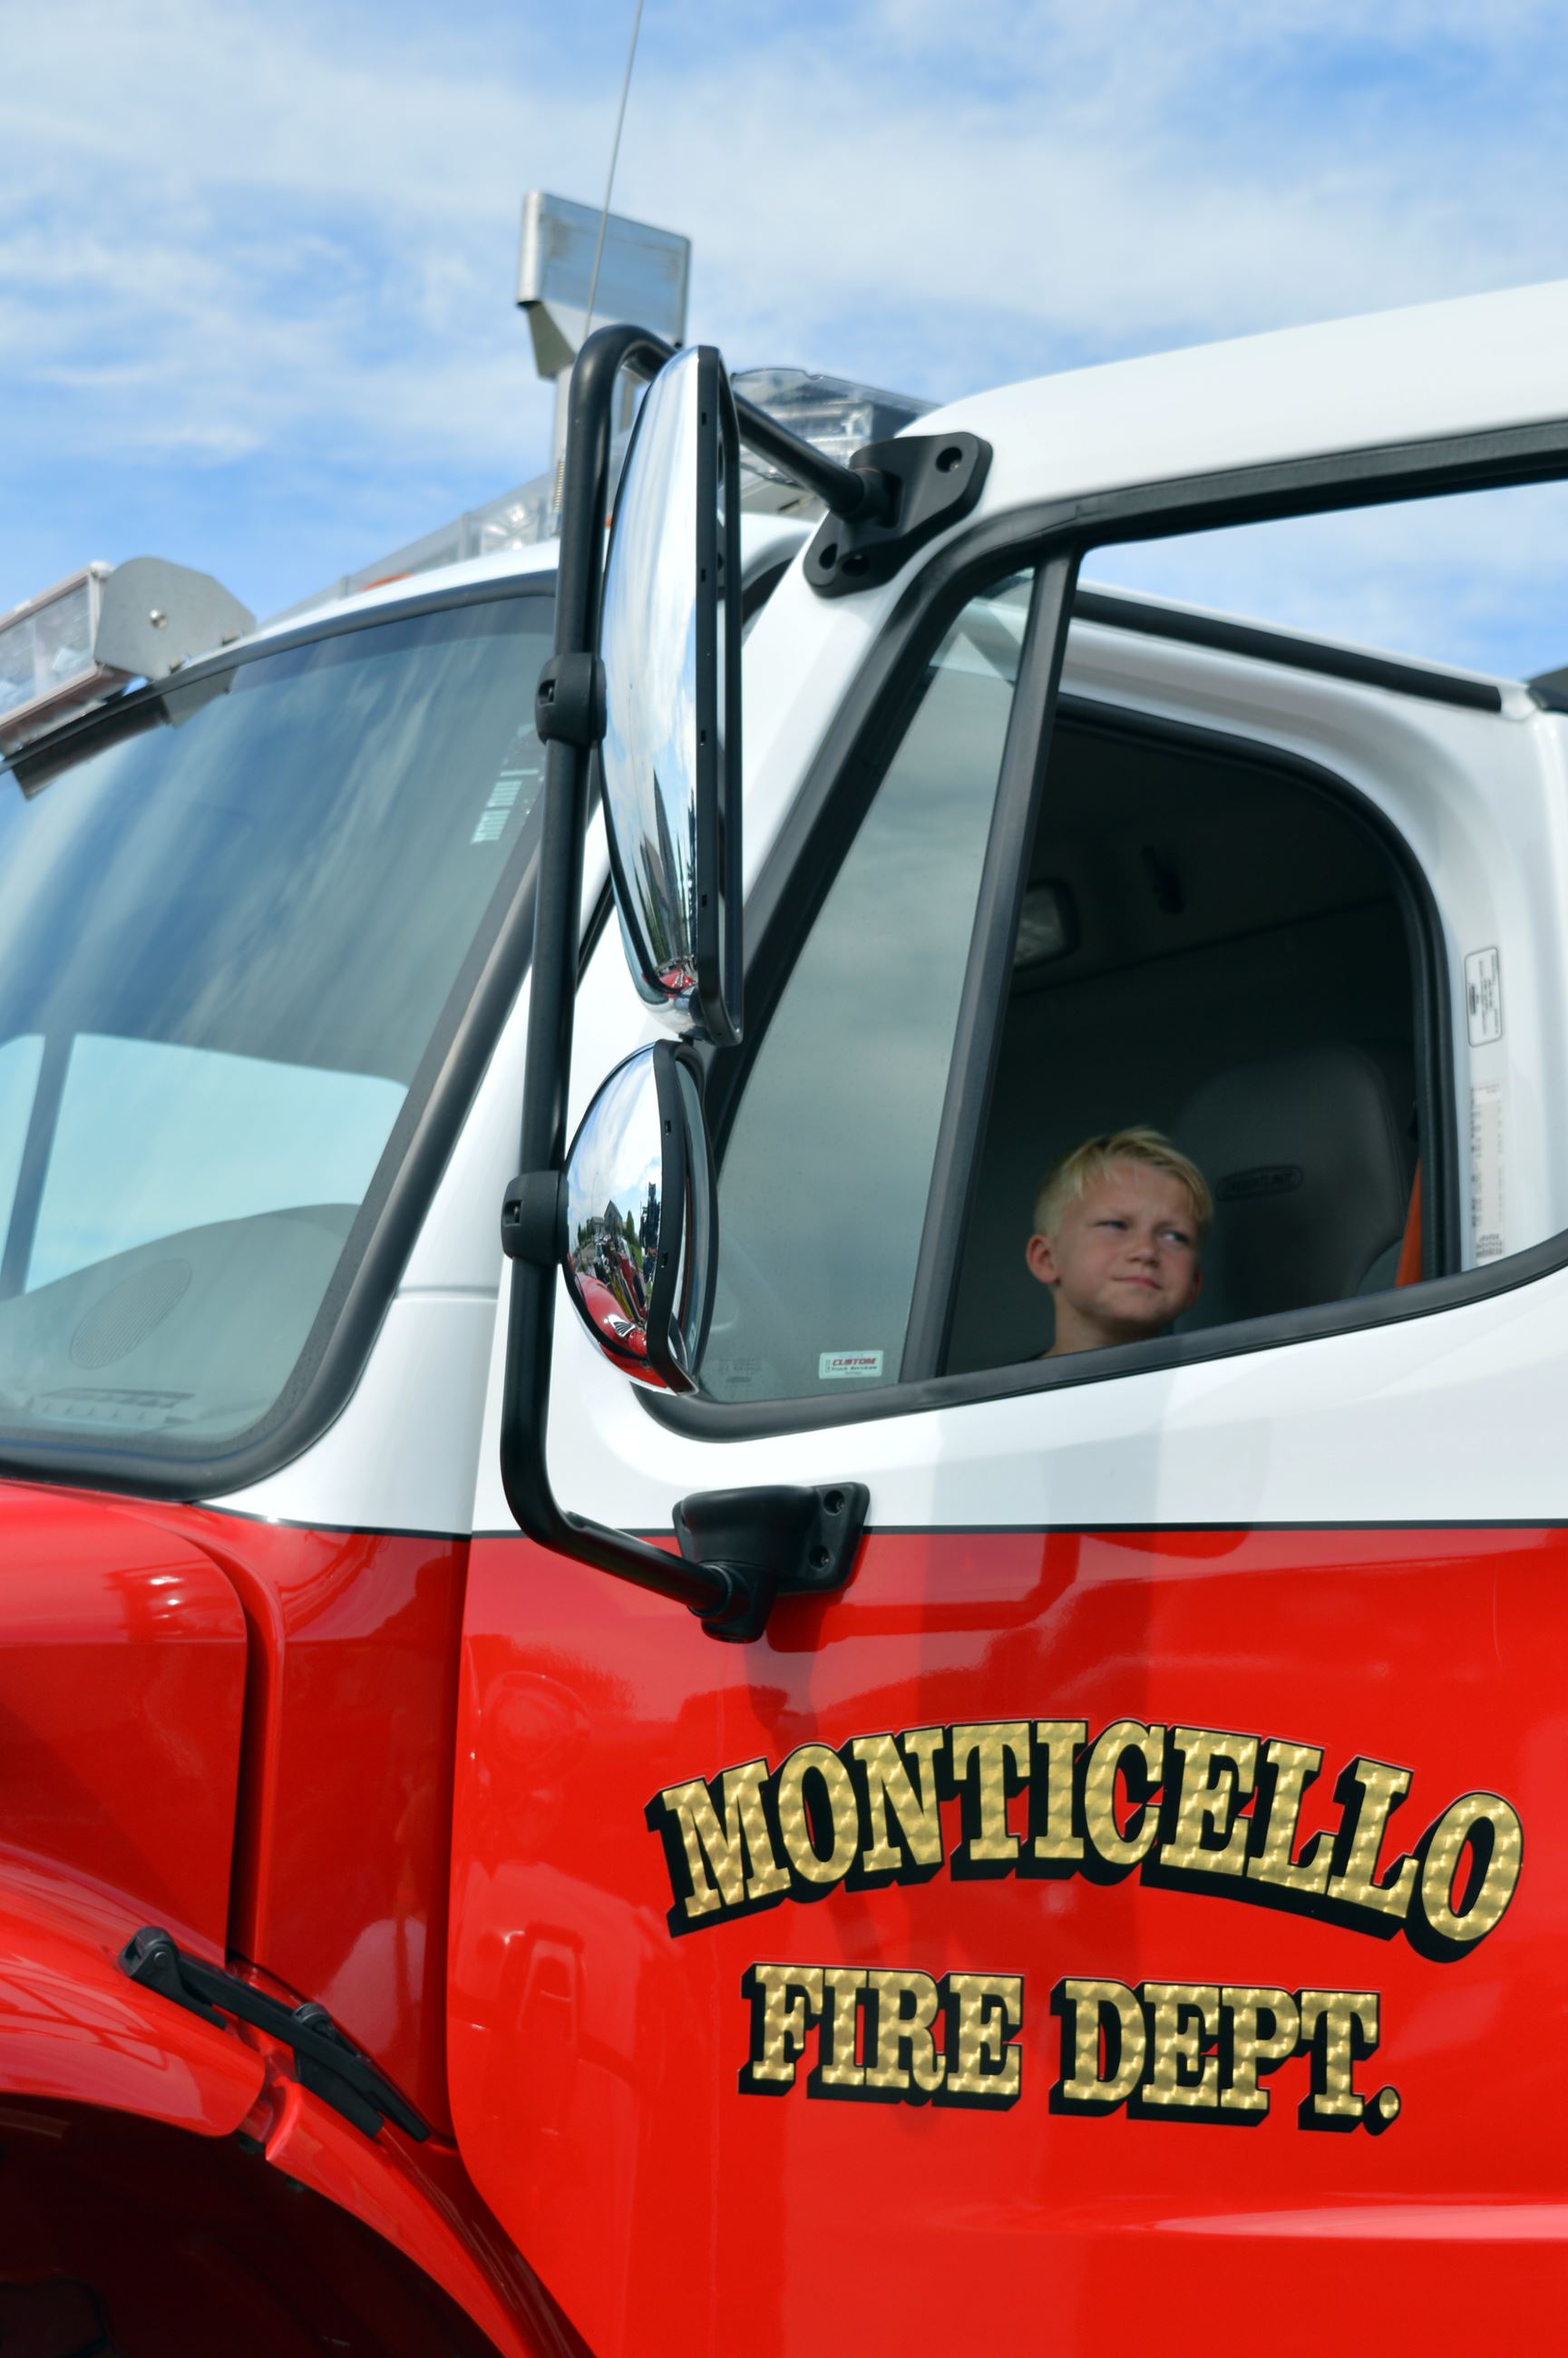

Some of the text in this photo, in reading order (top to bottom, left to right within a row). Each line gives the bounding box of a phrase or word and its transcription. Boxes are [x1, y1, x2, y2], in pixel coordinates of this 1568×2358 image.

[651, 1719, 1524, 1952] MONTICELLO
[745, 1963, 1402, 2128] FIRE DEPT.
